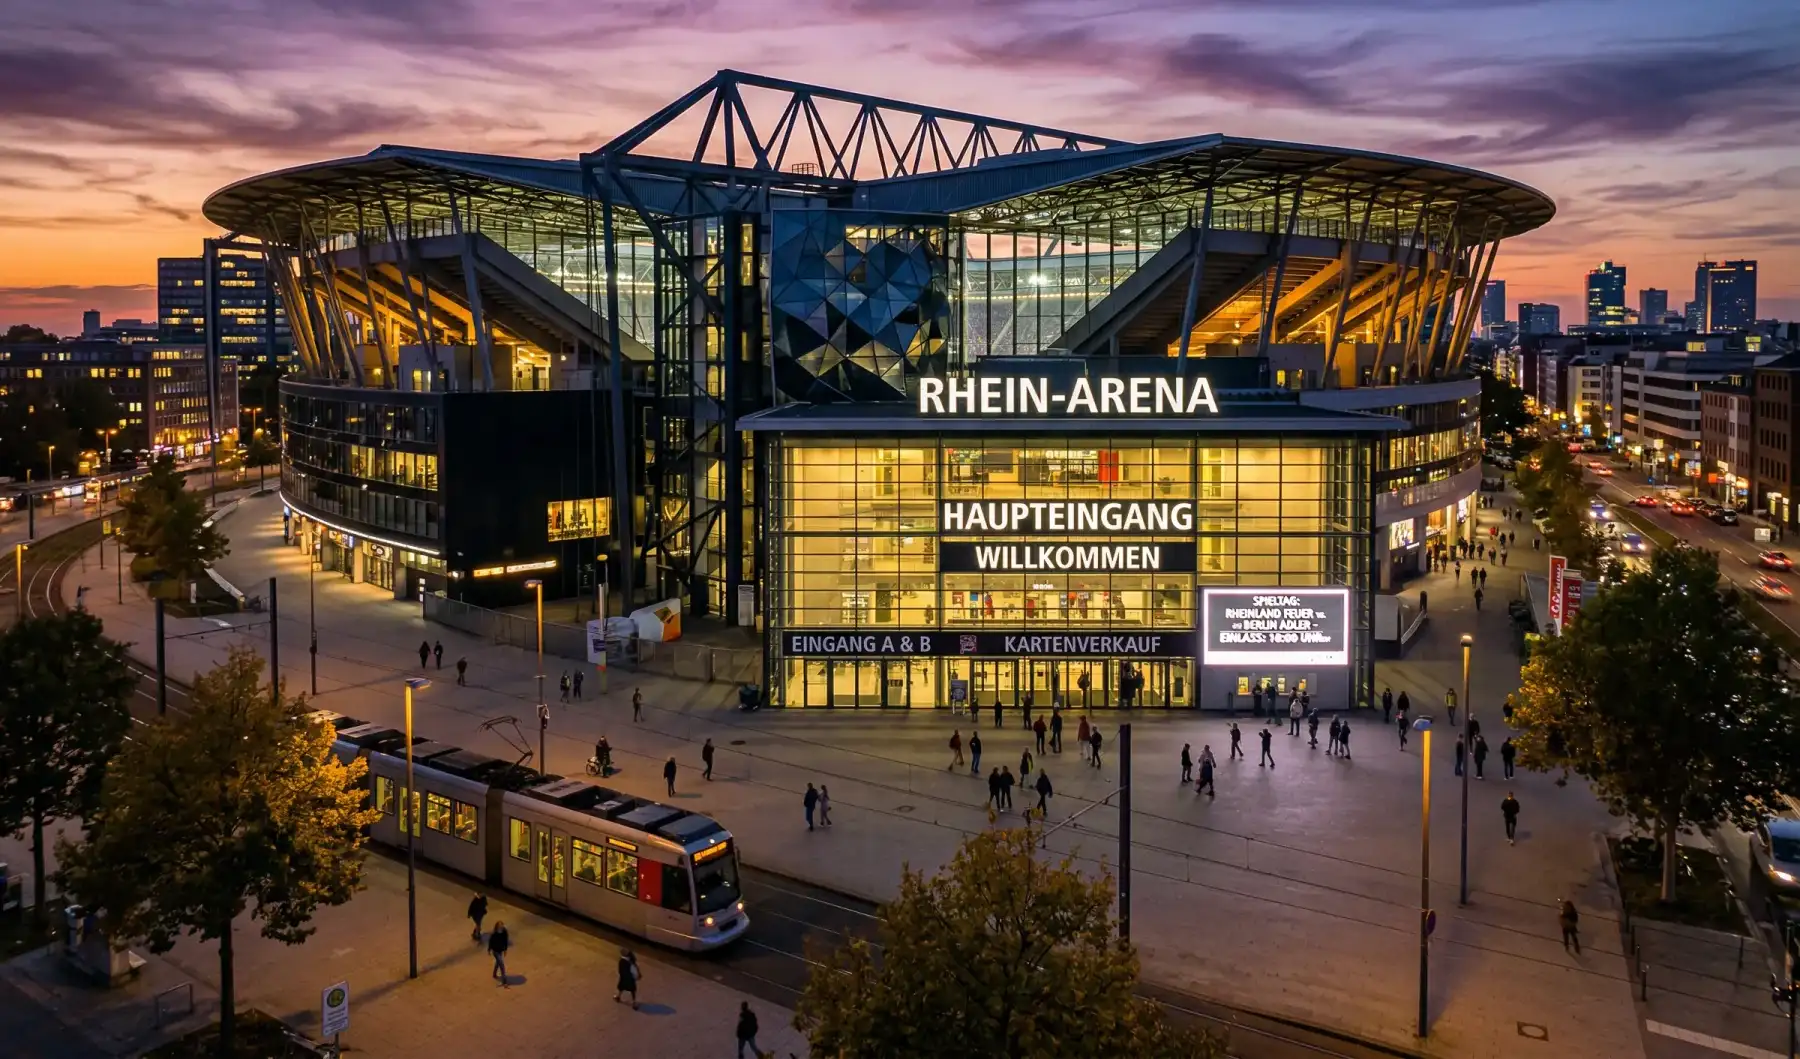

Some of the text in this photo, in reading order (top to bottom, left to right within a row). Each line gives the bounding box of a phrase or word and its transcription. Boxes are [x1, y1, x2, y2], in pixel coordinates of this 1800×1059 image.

[919, 377, 1219, 414] RHEIN-ARENA
[943, 502, 1193, 531] HAUPTEINGANG
[975, 545, 1160, 569] WILLKOMMEN
[1252, 595, 1301, 606] SPIELTAG:
[1225, 608, 1282, 619] RHEINLAND
[1283, 608, 1314, 619] FEUER
[1243, 619, 1278, 631] BERLIN
[1279, 619, 1311, 631] ADLER
[791, 636, 931, 654] EINGANG A & B
[1004, 636, 1161, 654] KARTENVERKAUF
